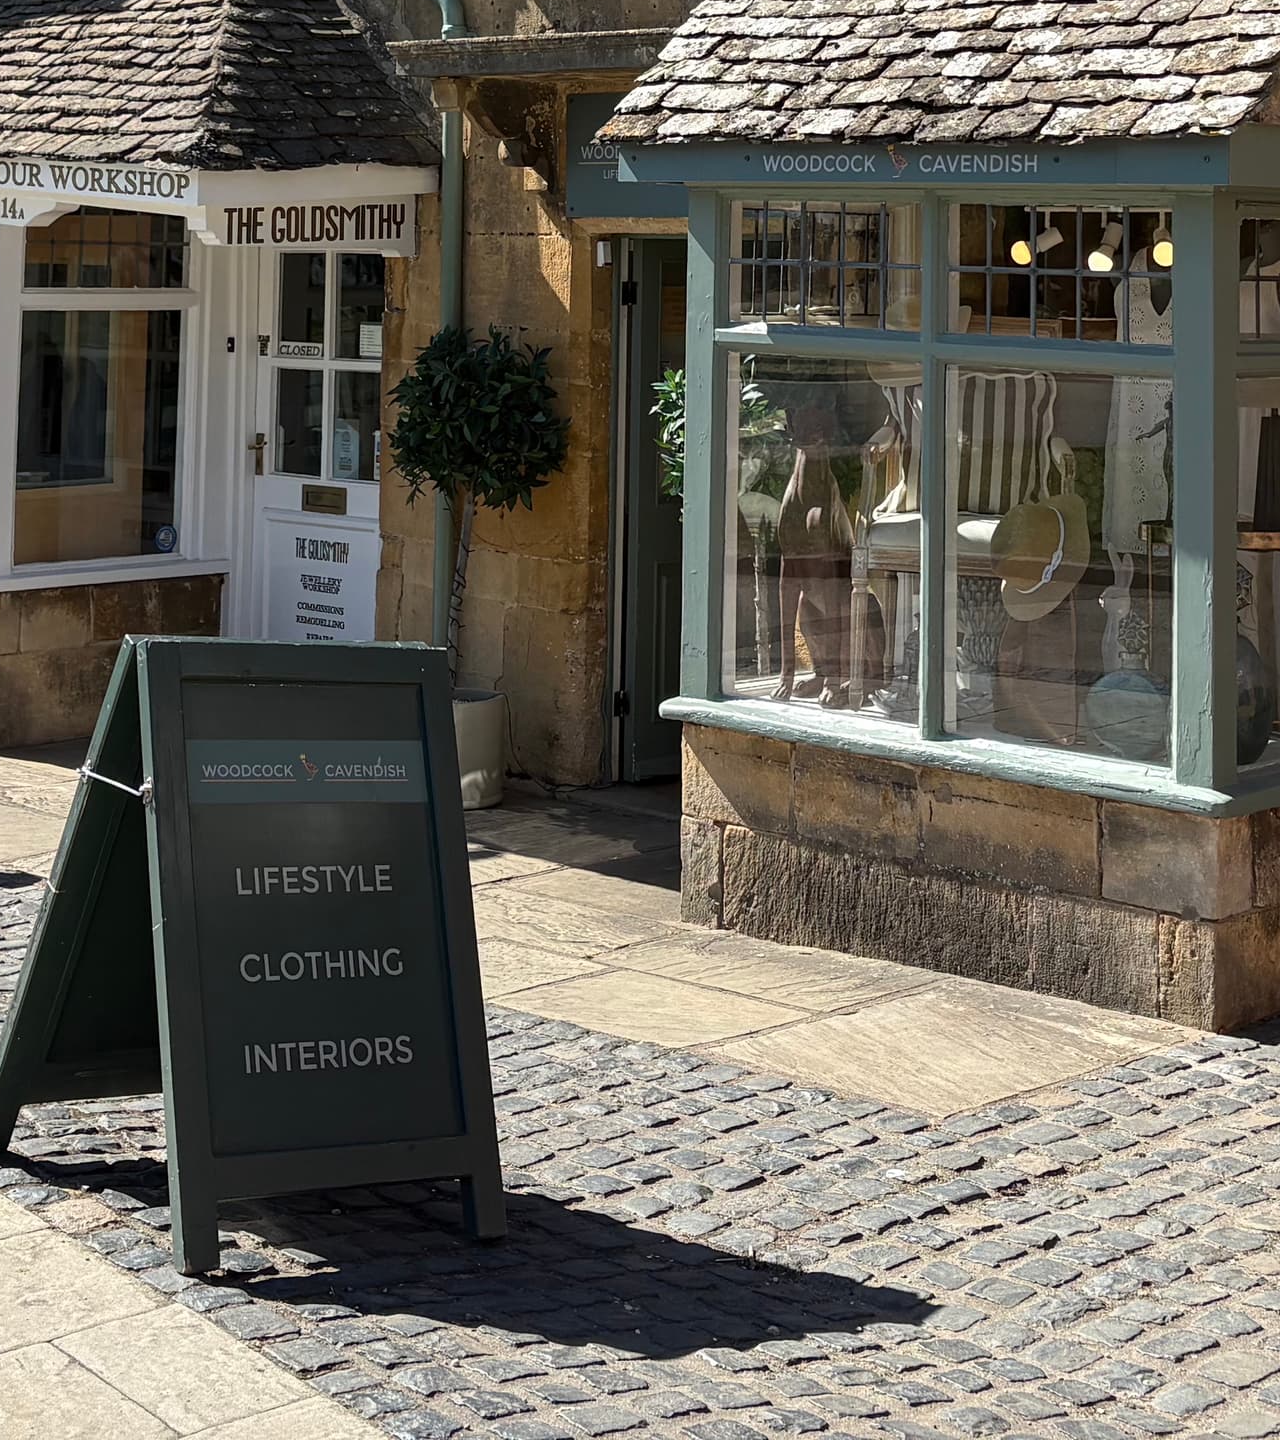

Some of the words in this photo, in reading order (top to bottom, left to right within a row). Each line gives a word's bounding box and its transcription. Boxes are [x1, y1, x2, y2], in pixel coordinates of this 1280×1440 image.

[762, 154, 876, 173] WOODCOCK
[919, 154, 1038, 173] CAVENDISH
[48, 164, 190, 199] WORKSHOP
[0, 197, 25, 220] 14A
[223, 206, 265, 245] THE
[271, 203, 406, 244] GOLDSMITHY
[279, 344, 320, 357] CLOSED
[295, 537, 307, 559] THE
[308, 539, 349, 564] GOLDSMITHY
[300, 573, 342, 588] JEWELLERY
[202, 763, 294, 778] WOODCOCK
[324, 763, 406, 778] CAVENDISH
[235, 864, 393, 895] LIFESTYLE
[239, 947, 404, 983] CLOTHING
[243, 1035, 414, 1075] INTERIORS
